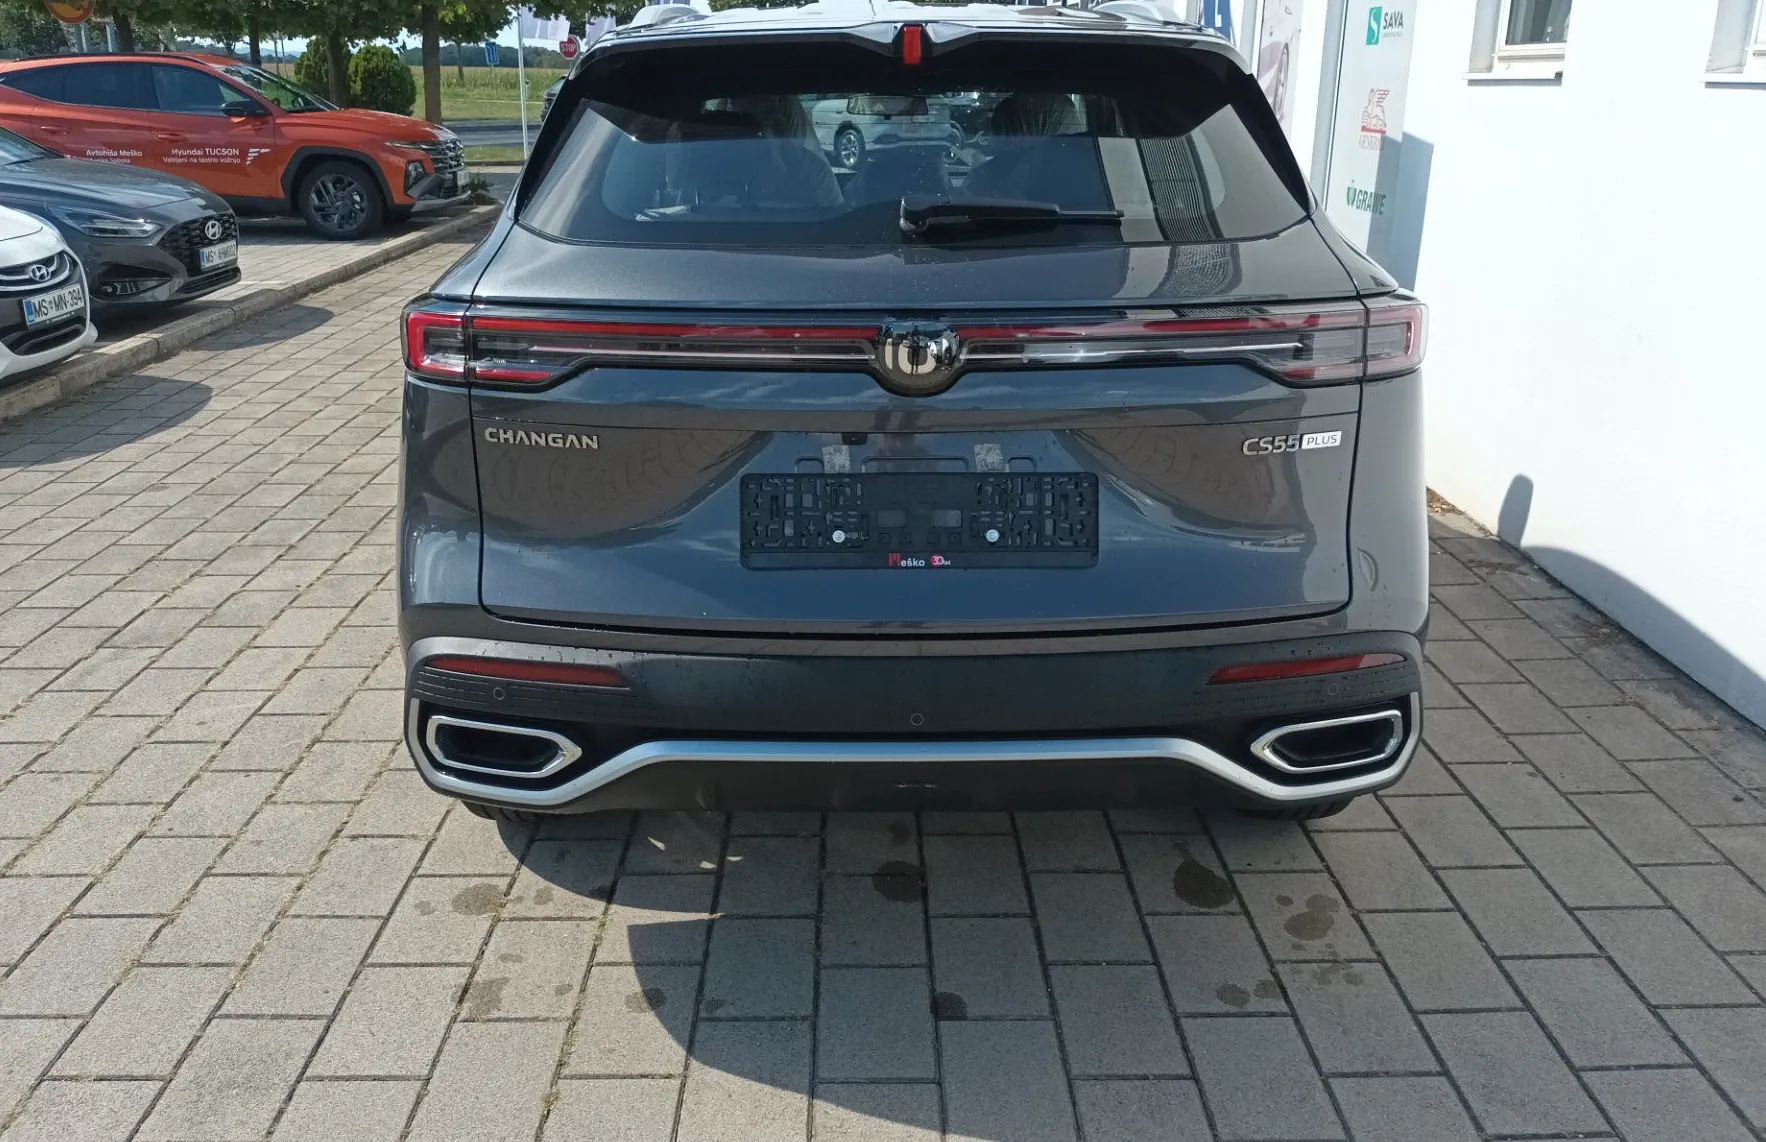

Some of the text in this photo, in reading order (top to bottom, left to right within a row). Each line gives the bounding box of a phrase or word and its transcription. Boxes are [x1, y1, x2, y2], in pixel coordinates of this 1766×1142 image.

[1383, 11, 1404, 30] SAVA
[560, 42, 577, 52] STOP
[119, 149, 142, 157] Meško
[171, 148, 239, 156] Hyundai TUCSON
[1355, 189, 1387, 216] GRAWE
[484, 427, 600, 450] CHANGAN
[1242, 434, 1338, 456] CS55 PLUS
[888, 552, 926, 568] Meško
